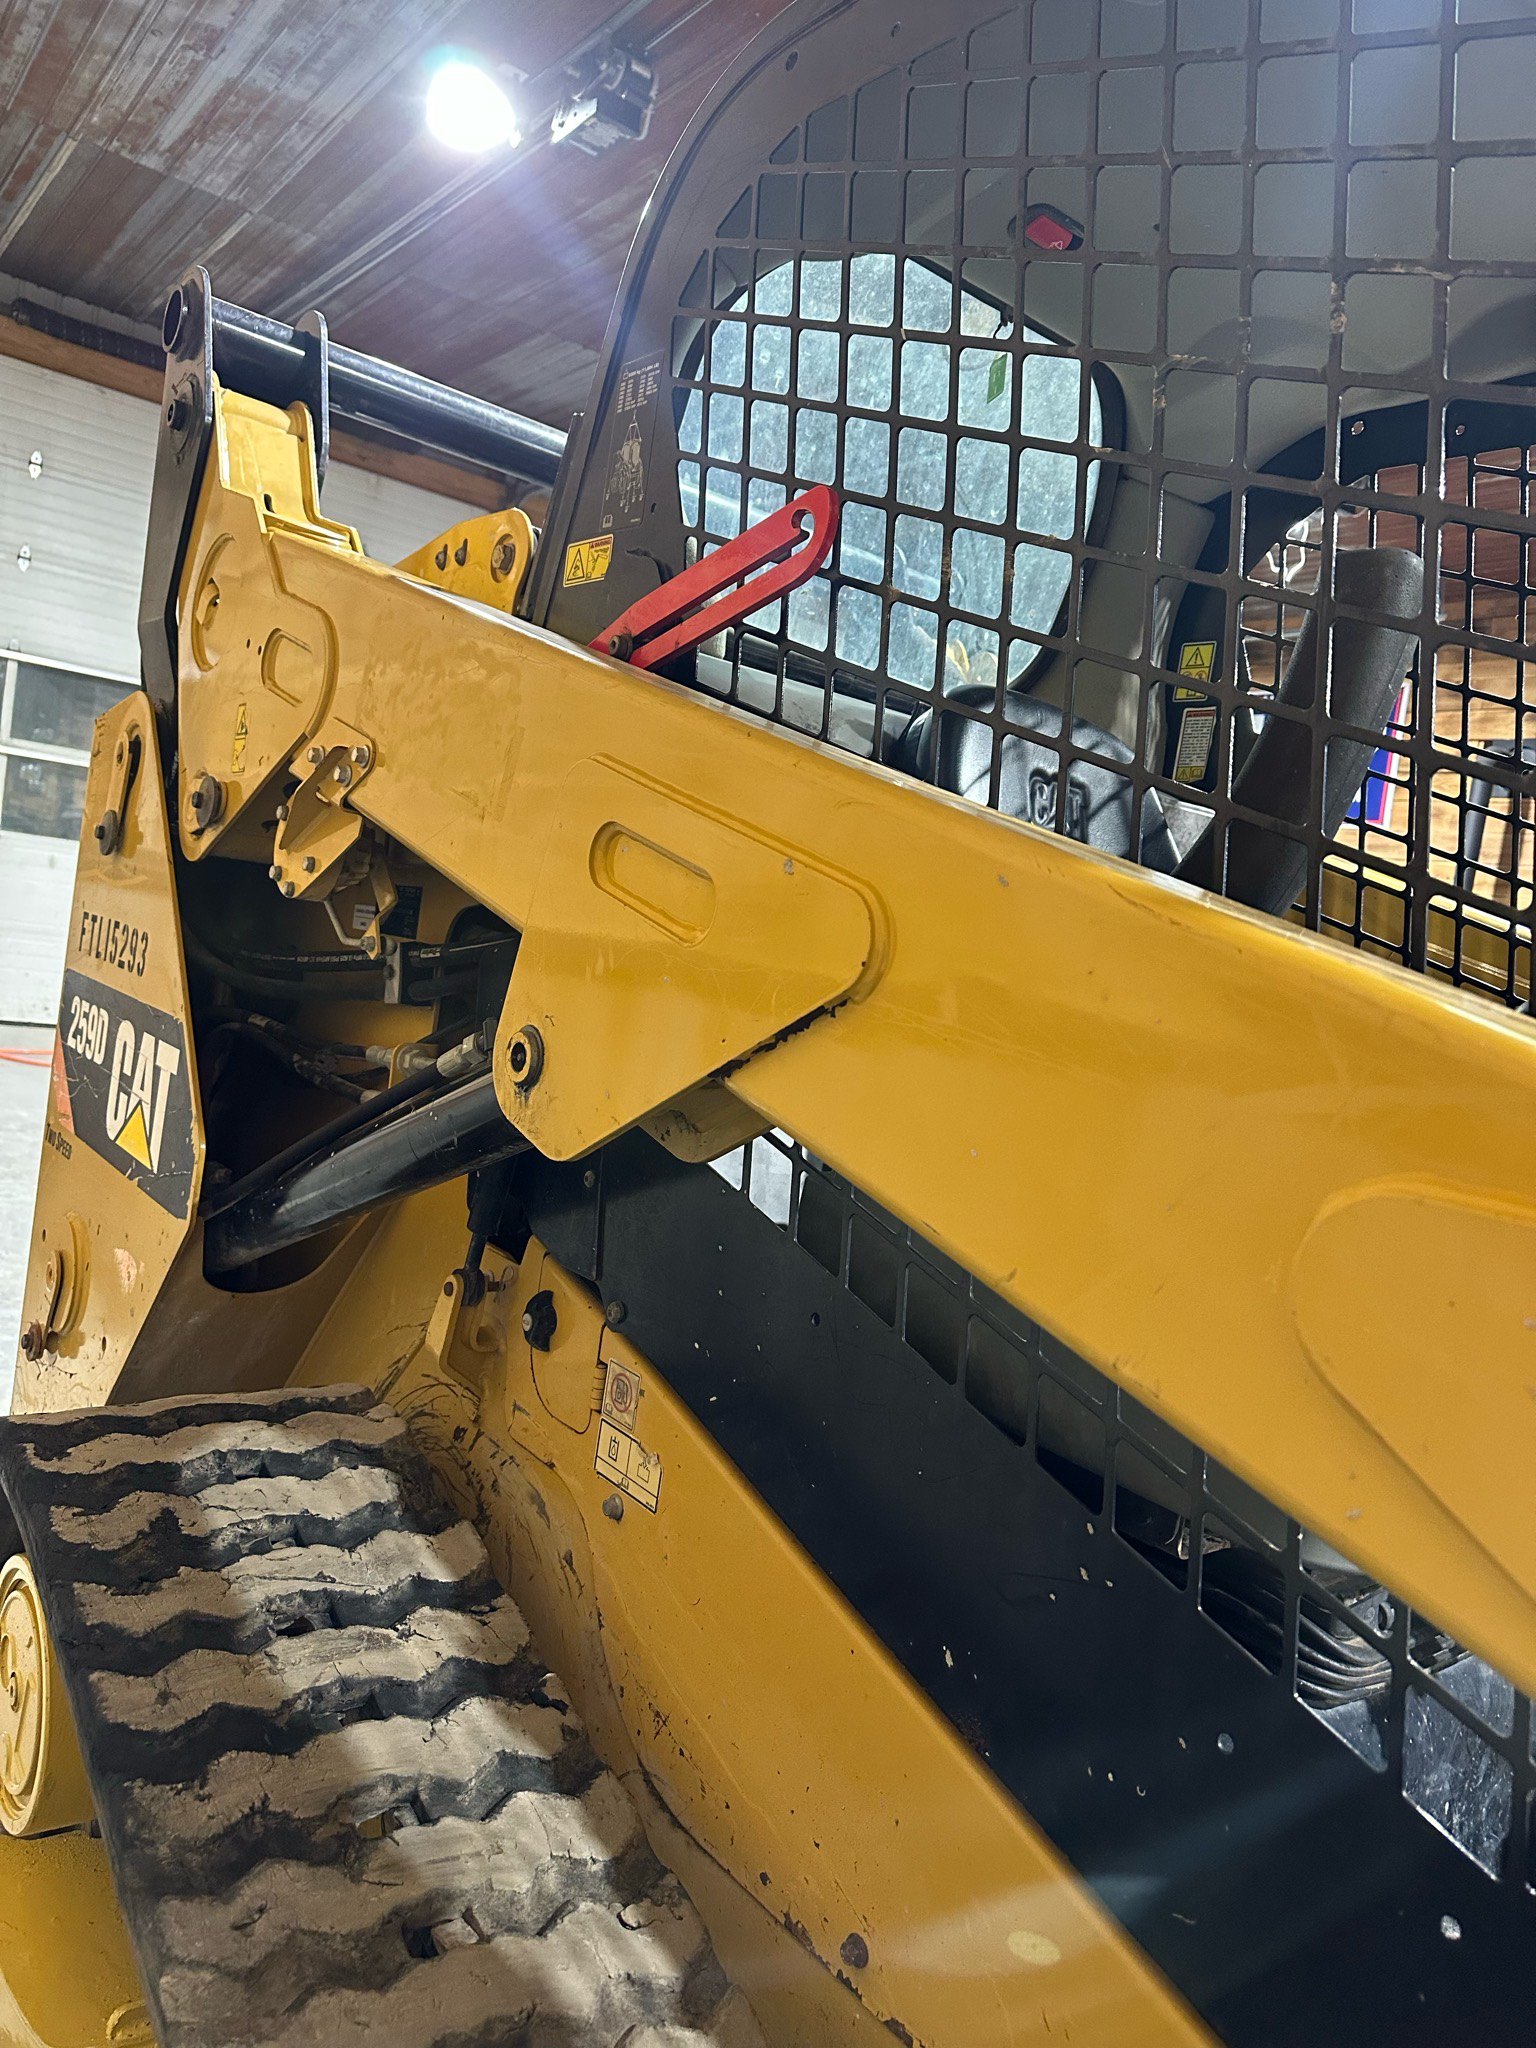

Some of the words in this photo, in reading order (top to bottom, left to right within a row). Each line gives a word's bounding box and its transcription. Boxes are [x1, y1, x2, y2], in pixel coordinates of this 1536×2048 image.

[79, 911, 149, 977] FTL15293
[67, 995, 109, 1066] 259D
[105, 1020, 180, 1175] CAT
